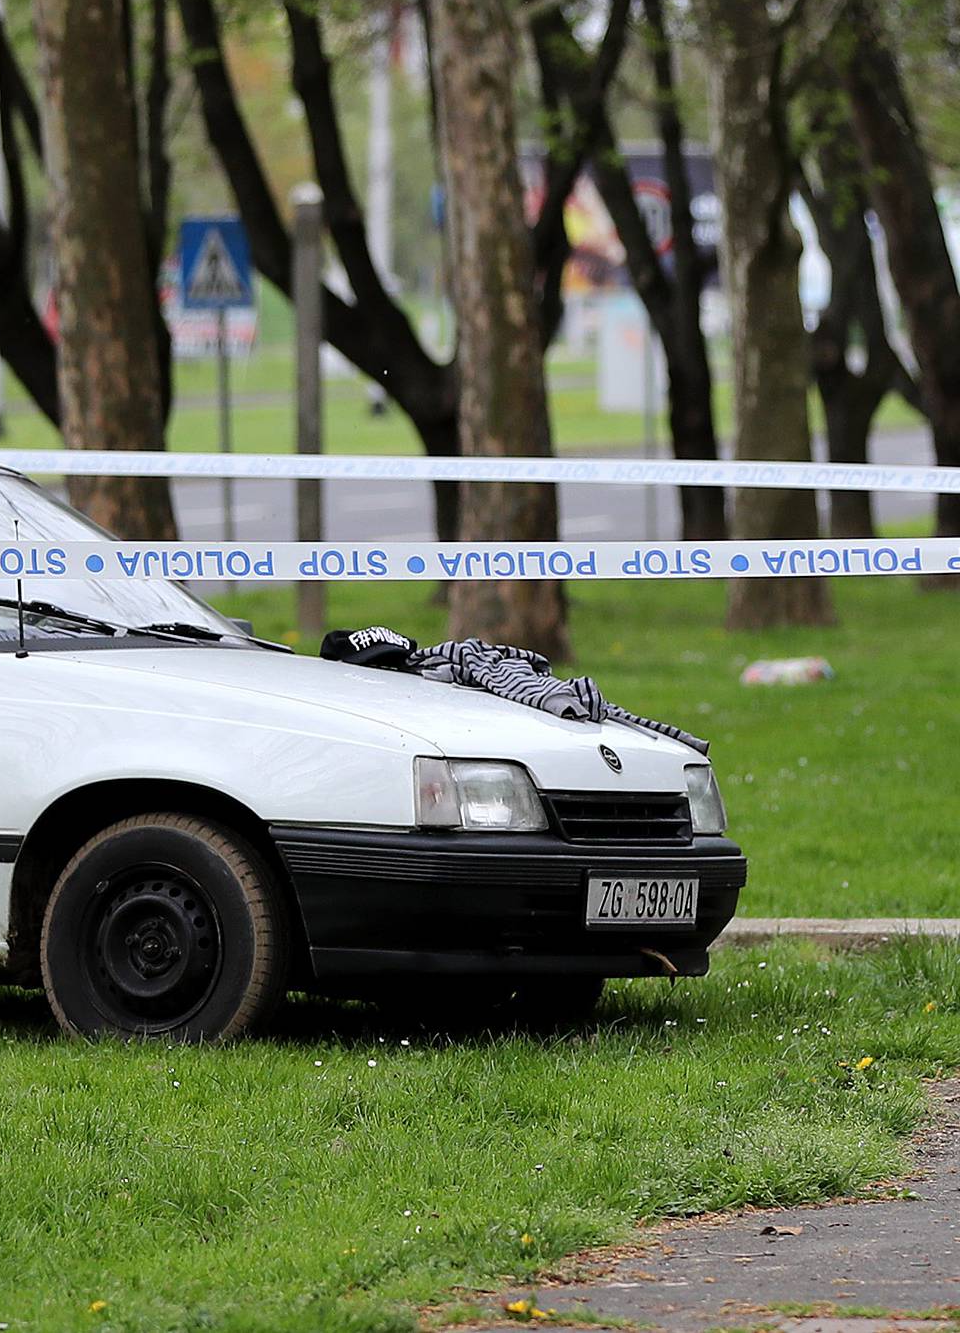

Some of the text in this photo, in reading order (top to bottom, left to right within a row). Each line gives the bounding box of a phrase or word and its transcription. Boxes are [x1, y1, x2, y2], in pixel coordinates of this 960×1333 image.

[117, 550, 273, 577] POLICIJA
[299, 549, 388, 577] STOP
[438, 551, 597, 577] POLICIJA
[622, 549, 711, 575] STOP
[762, 547, 921, 574] POLICIJA
[598, 882, 625, 918] ZG
